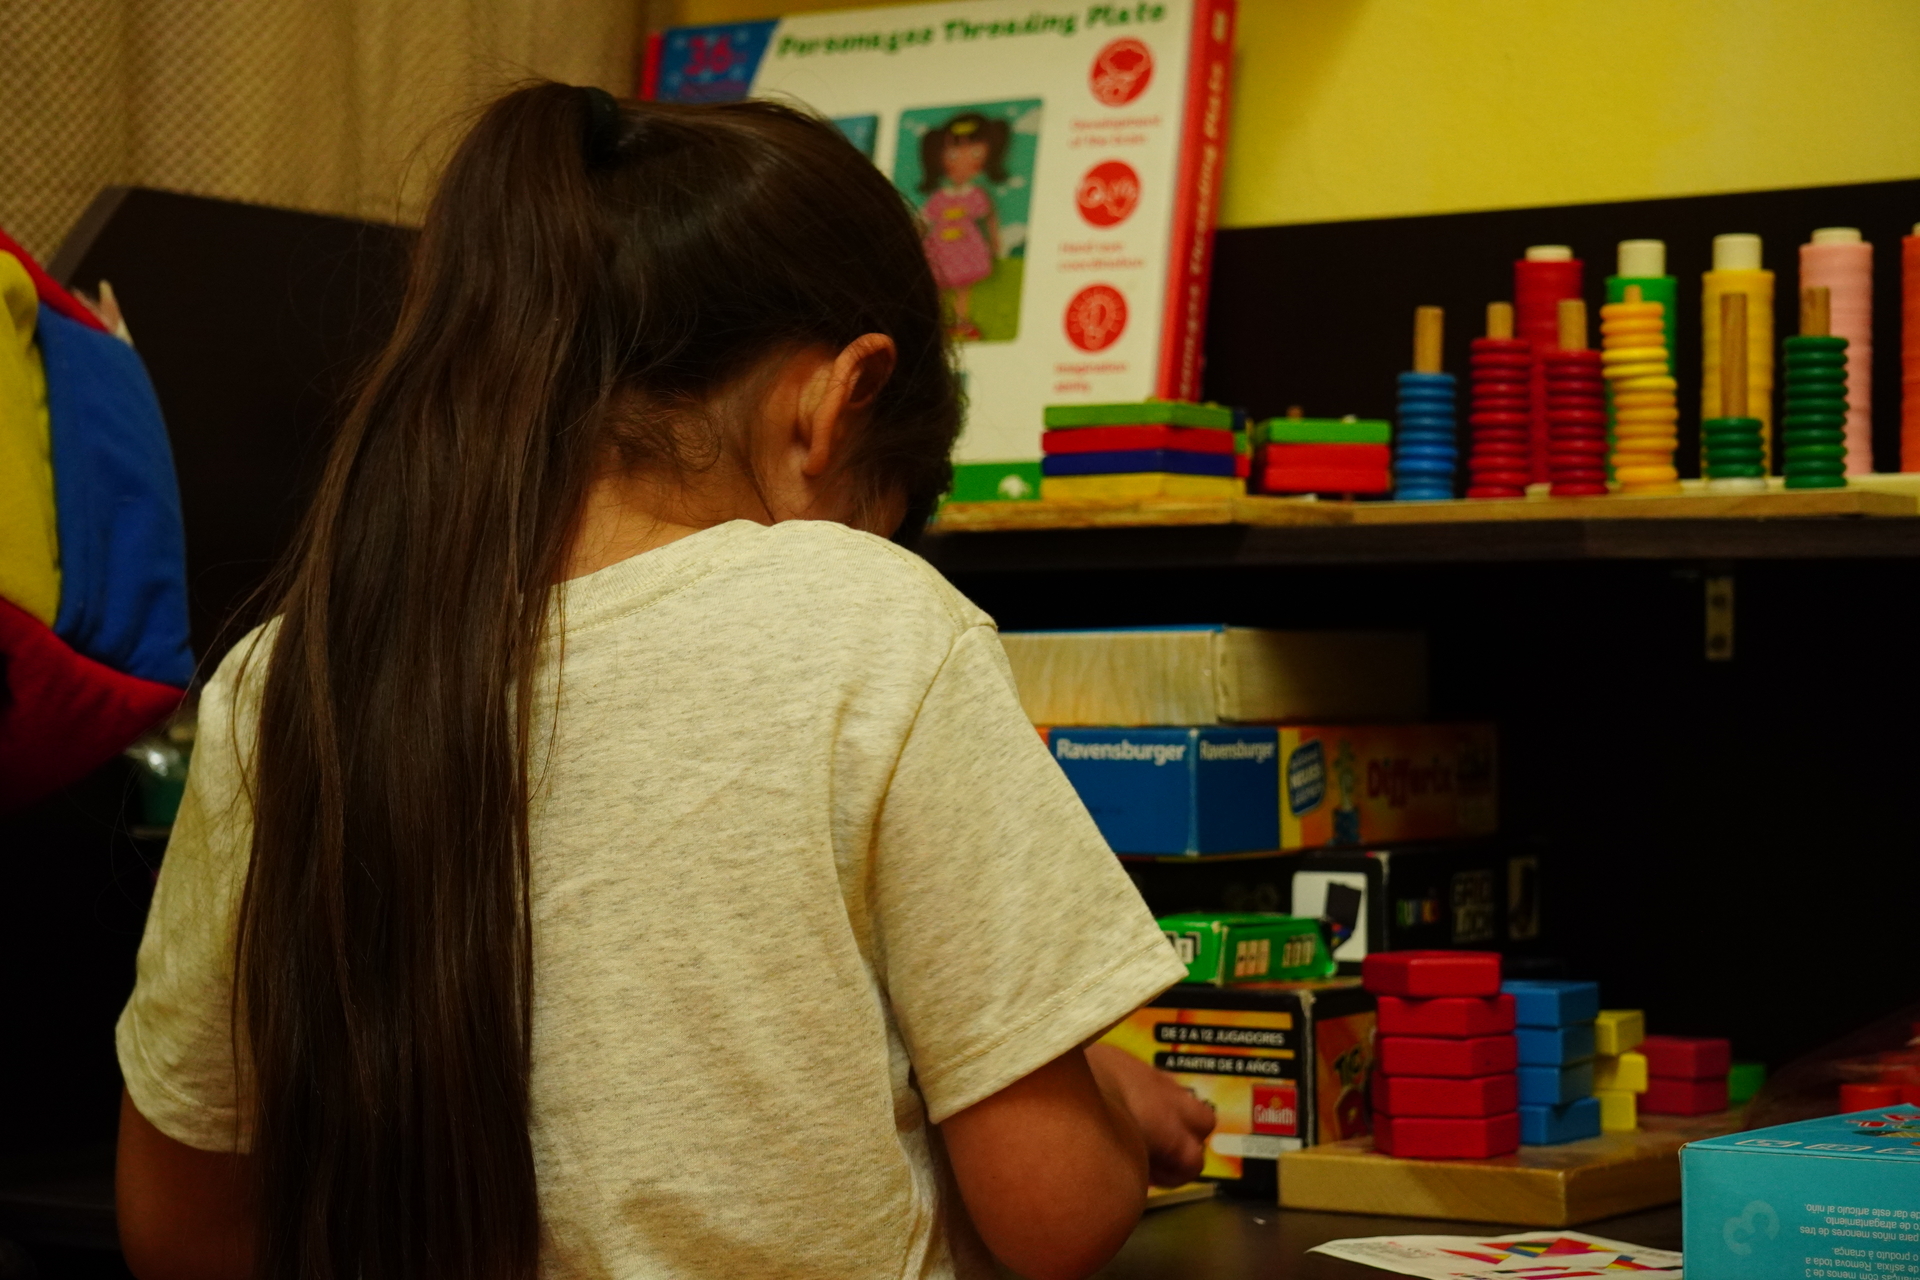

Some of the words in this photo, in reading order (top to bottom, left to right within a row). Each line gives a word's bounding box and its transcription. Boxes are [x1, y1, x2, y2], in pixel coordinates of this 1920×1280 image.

[945, 13, 1078, 41] Threading
[1086, 1, 1166, 29] Plate
[1056, 739, 1185, 766] Ravensburger
[1201, 740, 1274, 763] Ravensburger
[1161, 1026, 1177, 1040] DE
[1179, 1027, 1188, 1041] 2
[1189, 1027, 1199, 1041] A
[1201, 1028, 1214, 1042] 12
[1215, 1029, 1285, 1046] JUGADORES
[1165, 1055, 1175, 1069] A
[1177, 1055, 1216, 1070] PARTIR
[1217, 1058, 1233, 1072] DE
[1235, 1058, 1245, 1072] 8
[1246, 1058, 1280, 1074] AÑOS
[1254, 1104, 1294, 1125] Goliath
[1804, 1203, 1825, 1213] niño.
[1827, 1205, 1836, 1213] al
[1872, 1208, 1891, 1218] este
[1893, 1210, 1908, 1219] dar
[1824, 1216, 1897, 1230] atragantamiento.
[1899, 1222, 1911, 1231] de
[1800, 1226, 1816, 1236] tres
[1818, 1227, 1829, 1237] de
[1832, 1228, 1870, 1239] menores
[1873, 1231, 1896, 1242] niños
[1899, 1233, 1919, 1242] para
[1832, 1247, 1866, 1259] criança.
[1877, 1251, 1910, 1262] produto
[1814, 1257, 1832, 1267] toda
[1835, 1259, 1871, 1271] Remova
[1805, 1268, 1811, 1277] 3
[1874, 1262, 1905, 1273] asfixia.
[1908, 1265, 1919, 1274] de
[1814, 1269, 1824, 1278] de
[1827, 1270, 1856, 1279] menos
